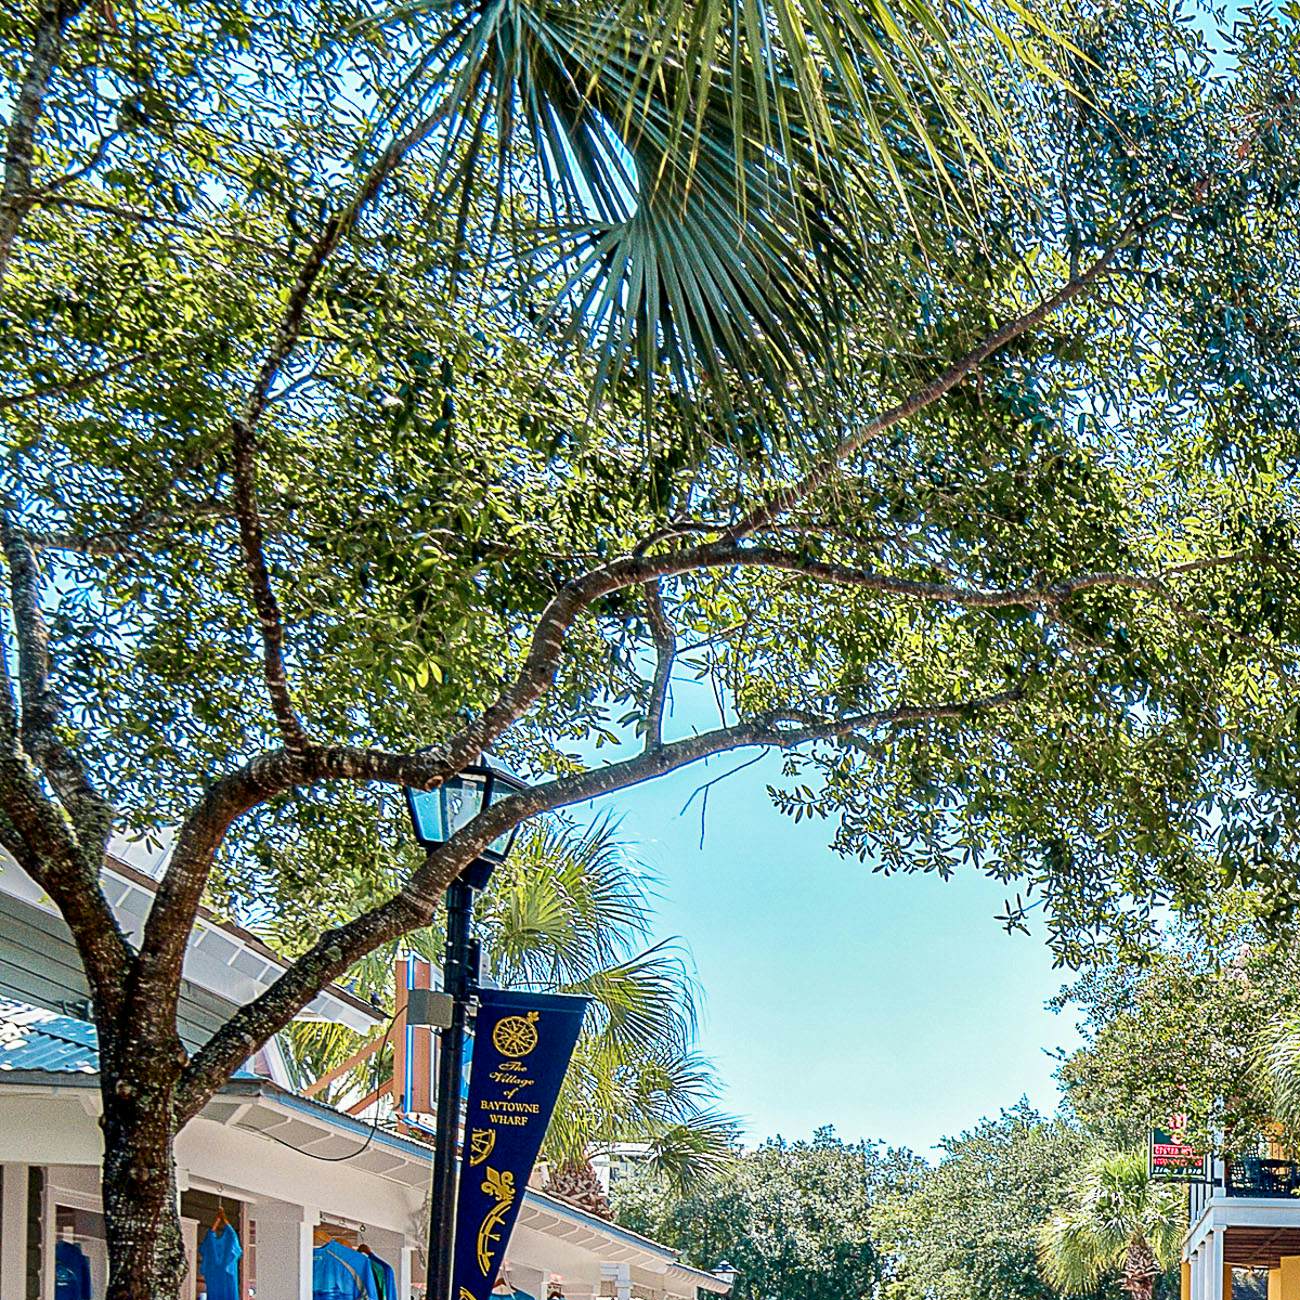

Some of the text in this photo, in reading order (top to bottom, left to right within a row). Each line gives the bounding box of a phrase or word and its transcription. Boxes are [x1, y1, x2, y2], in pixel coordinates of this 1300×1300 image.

[499, 1061, 527, 1072] The
[489, 1071, 534, 1087] Village
[503, 1087, 519, 1099] of
[480, 1100, 540, 1114] BAYTOWNE
[489, 1114, 528, 1126] WHARF
